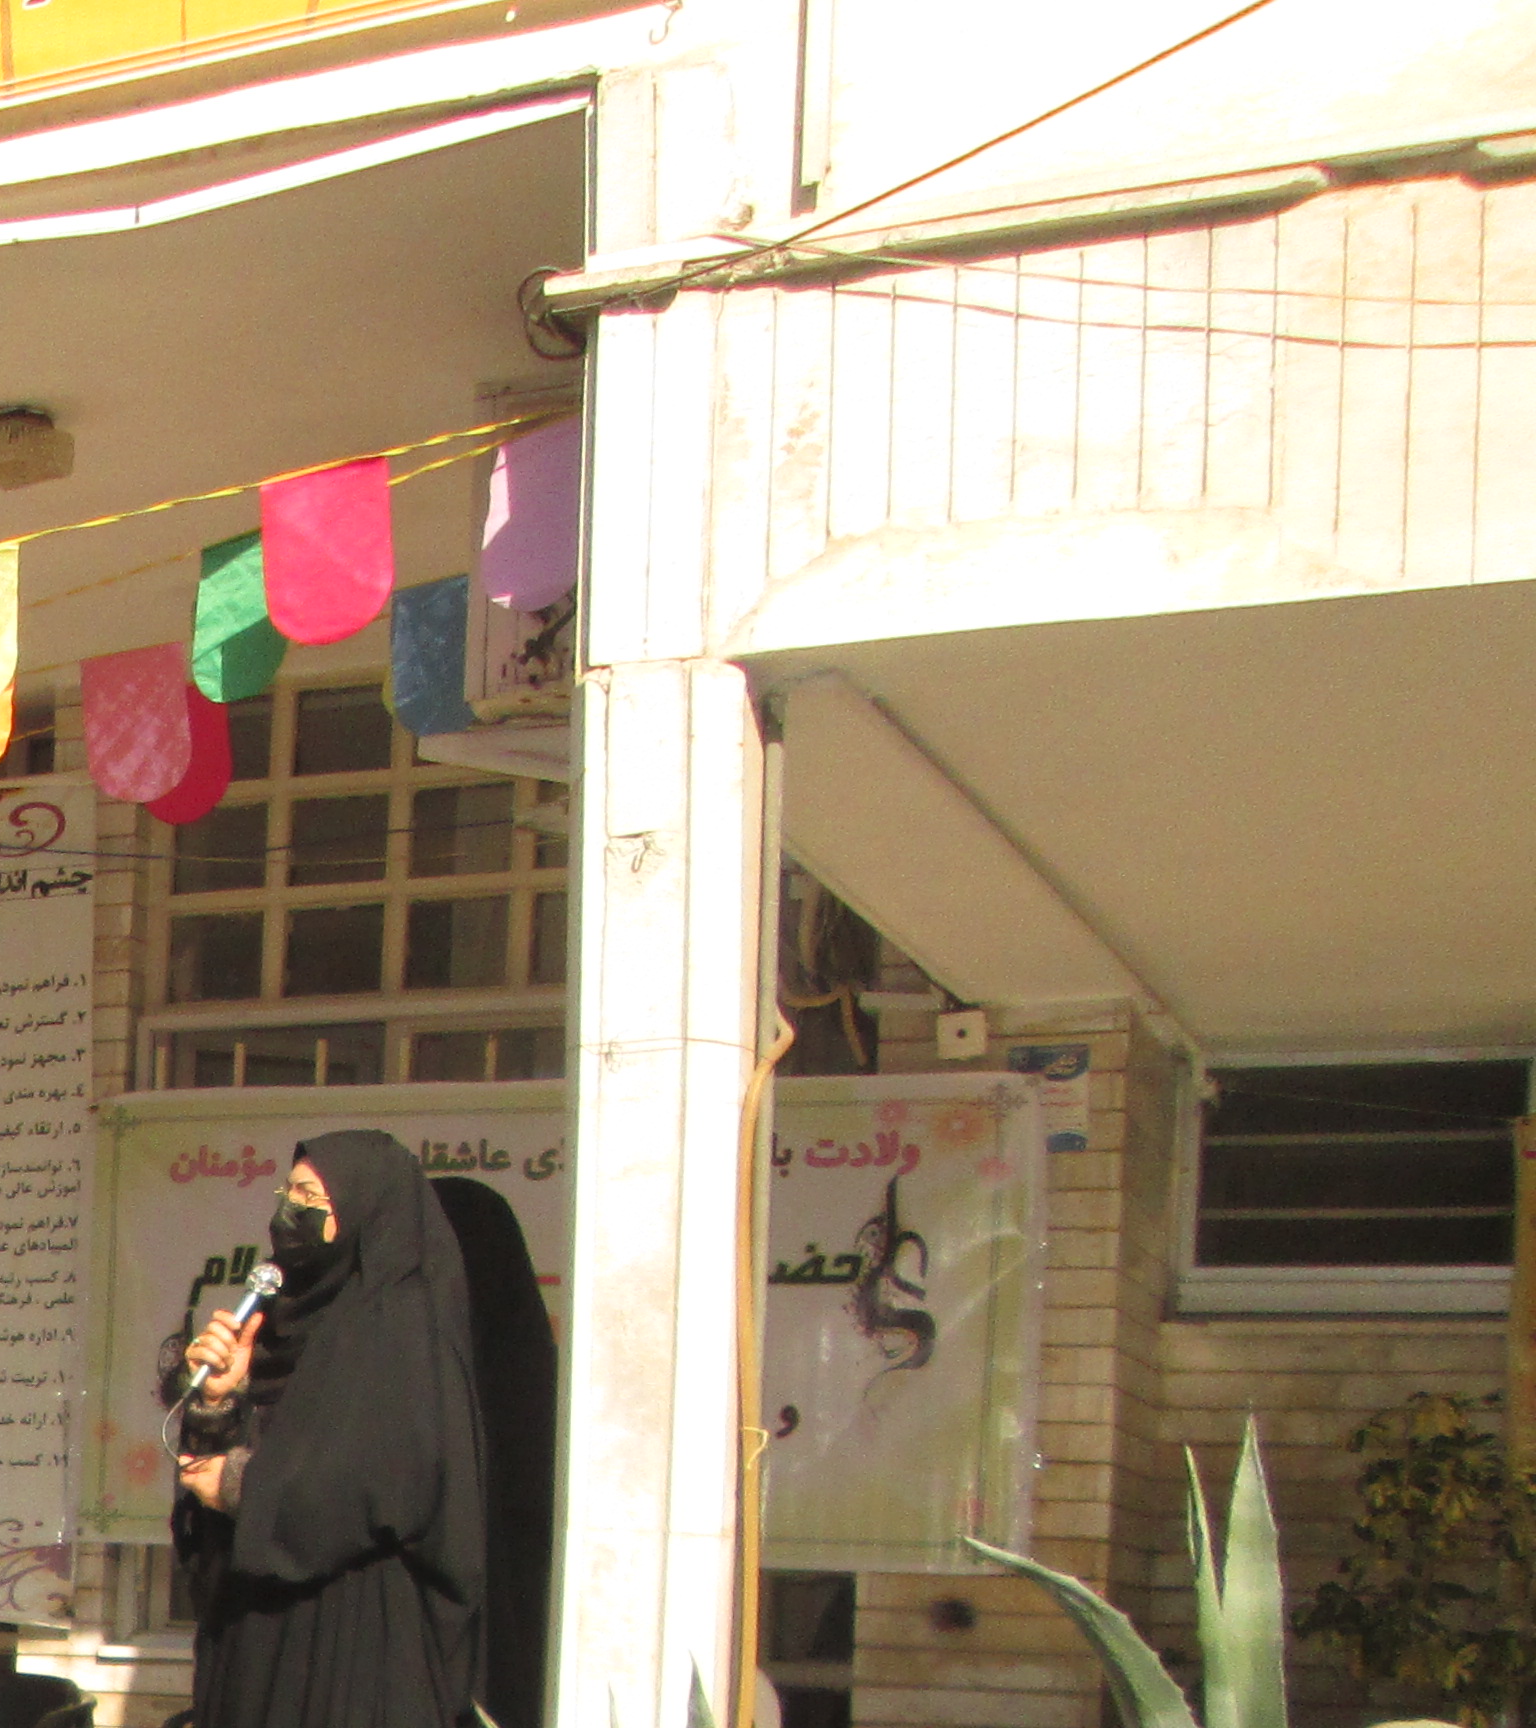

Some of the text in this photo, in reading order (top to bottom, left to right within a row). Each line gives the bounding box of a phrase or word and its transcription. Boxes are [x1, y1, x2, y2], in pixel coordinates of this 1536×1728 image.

[169, 1144, 278, 1187] مؤمنان
[421, 1137, 512, 1173] عاشقا
[804, 1130, 921, 1176] ولادت
